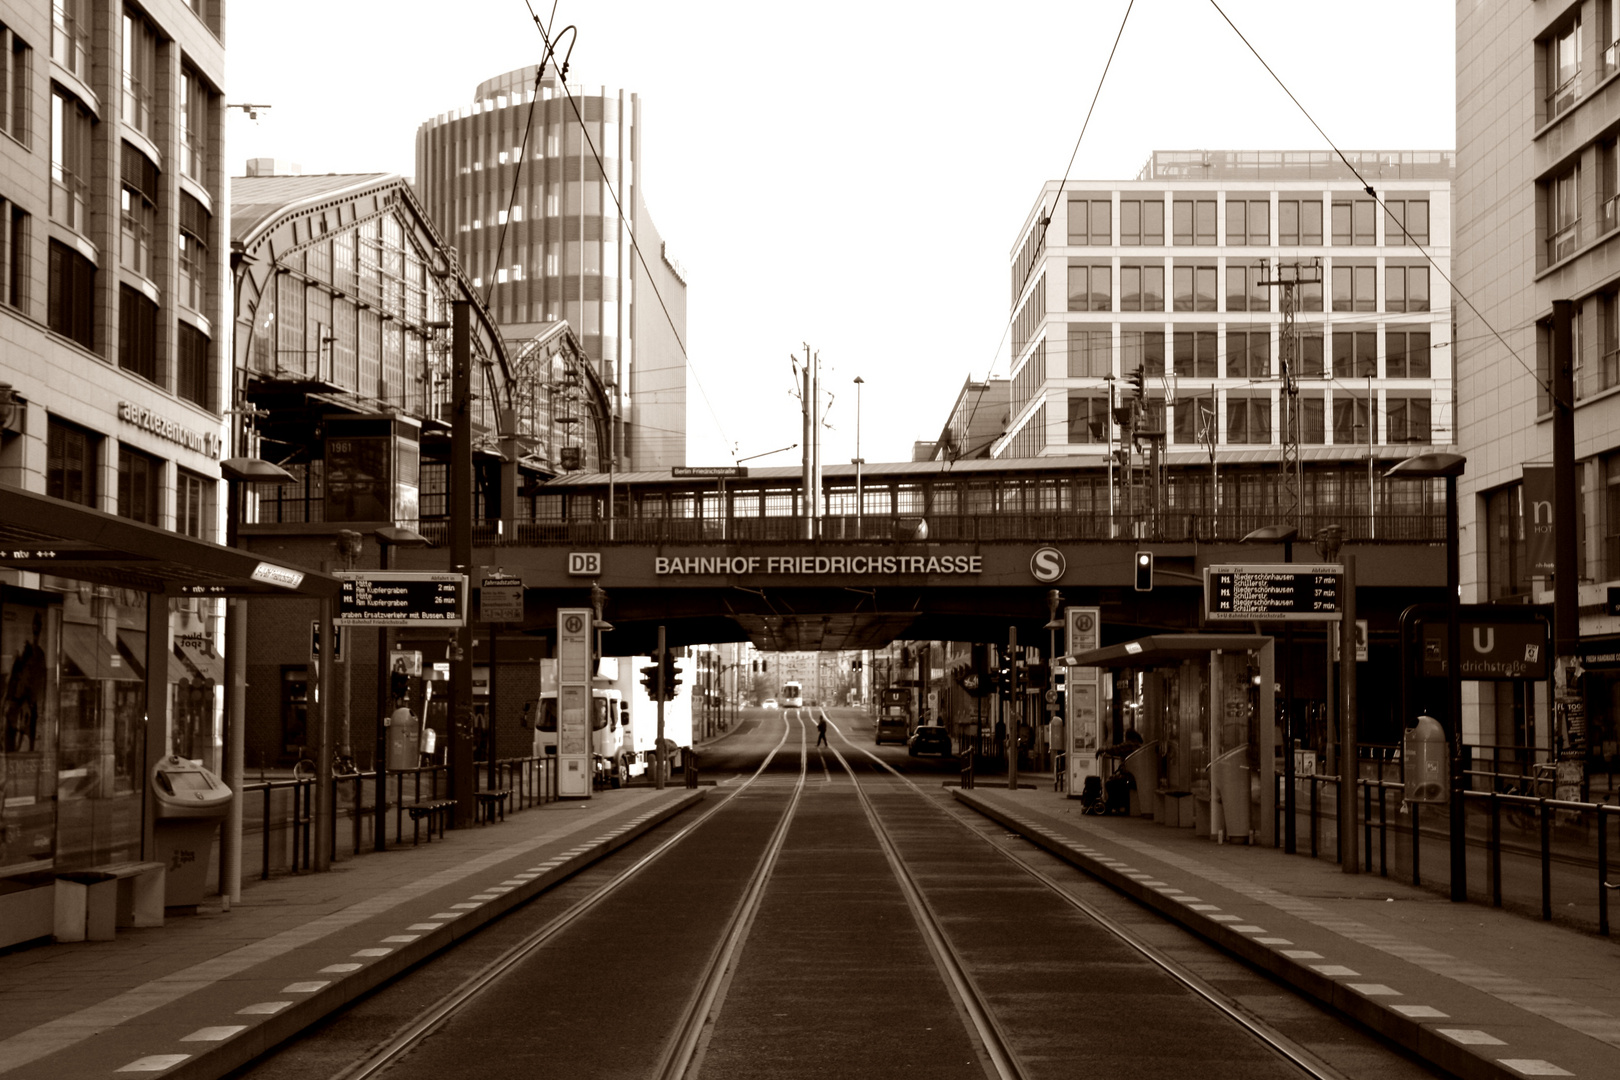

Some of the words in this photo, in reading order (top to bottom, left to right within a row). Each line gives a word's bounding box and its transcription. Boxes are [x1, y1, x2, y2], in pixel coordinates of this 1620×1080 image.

[121, 400, 203, 452] aerztezentrum
[331, 442, 352, 453] 1961
[13, 550, 30, 559] ntv
[572, 555, 597, 572] DB
[654, 556, 761, 575] BAHNHOF
[767, 555, 983, 574] FRIEDRICHSTRASSE
[1035, 550, 1061, 580] S
[484, 579, 521, 587] fahrradstation
[1221, 576, 1231, 584] M1
[1220, 588, 1230, 597] M1
[1314, 589, 1322, 597] 37
[1323, 589, 1335, 597] min
[1220, 601, 1230, 609] M1
[1233, 598, 1293, 606] Niederschönhausen
[1314, 602, 1322, 610] 57
[1323, 602, 1334, 610] min
[1472, 627, 1495, 654] U
[1441, 660, 1527, 672] Fdrichstraße
